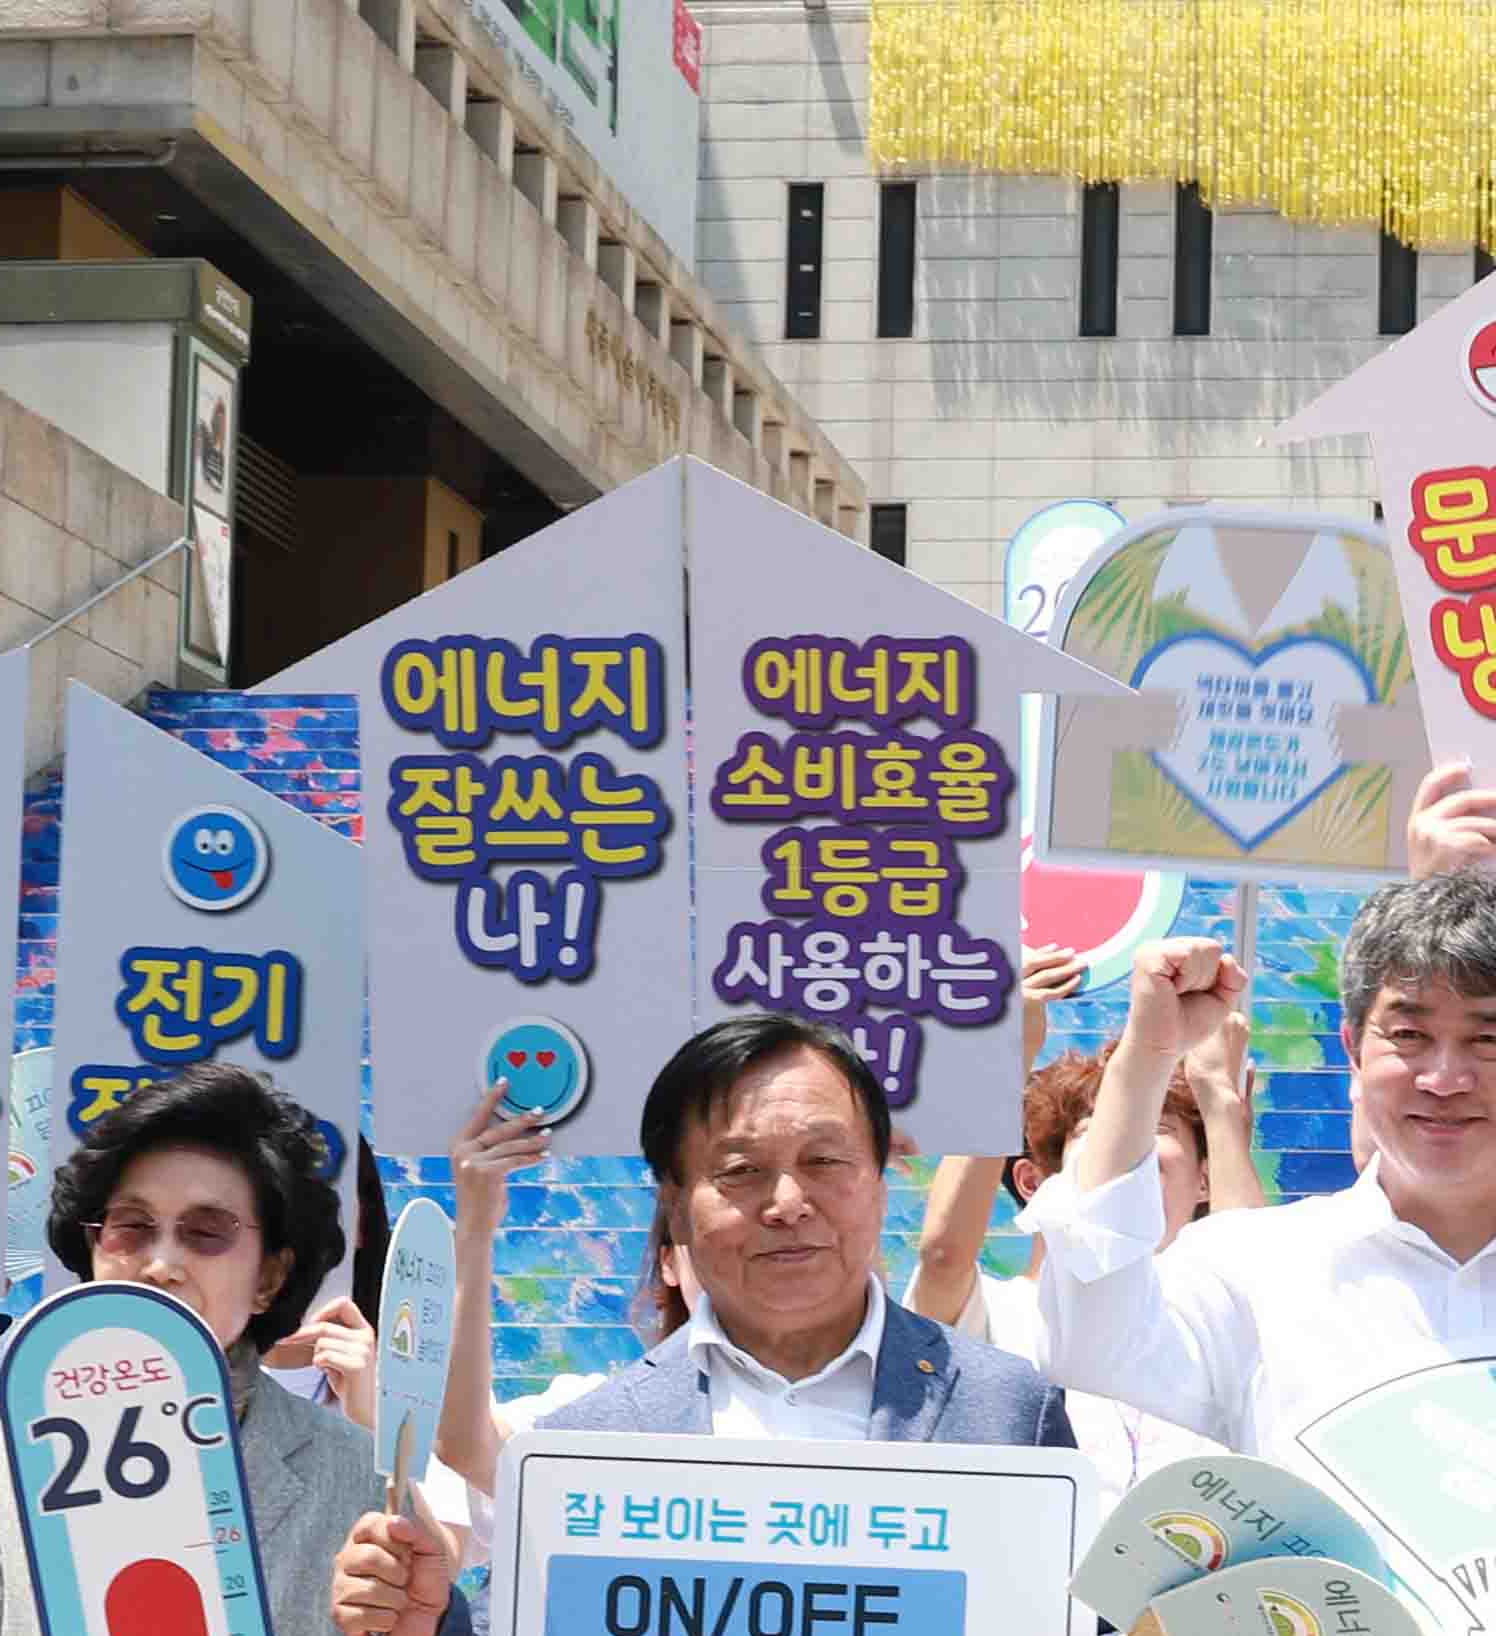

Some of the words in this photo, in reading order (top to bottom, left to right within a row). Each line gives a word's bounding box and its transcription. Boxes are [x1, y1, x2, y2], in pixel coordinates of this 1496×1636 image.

[393, 646, 648, 734] 에너지
[753, 647, 959, 716] 에너지
[400, 764, 656, 866] 잘쓰는
[722, 741, 998, 823] 소비효율
[773, 839, 949, 917] 1등급
[466, 882, 580, 968] 나!
[127, 957, 285, 1051] 전기
[724, 931, 999, 1011] 사용하는
[53, 1356, 170, 1398] 건강온도
[215, 1527, 241, 1545] 26
[565, 1492, 605, 1538] 잘
[621, 1496, 748, 1544] 보이는
[766, 1501, 849, 1549] 곳에
[868, 1505, 950, 1552] 두고
[1191, 1470, 1284, 1541] 에너지
[225, 1574, 245, 1590] 20
